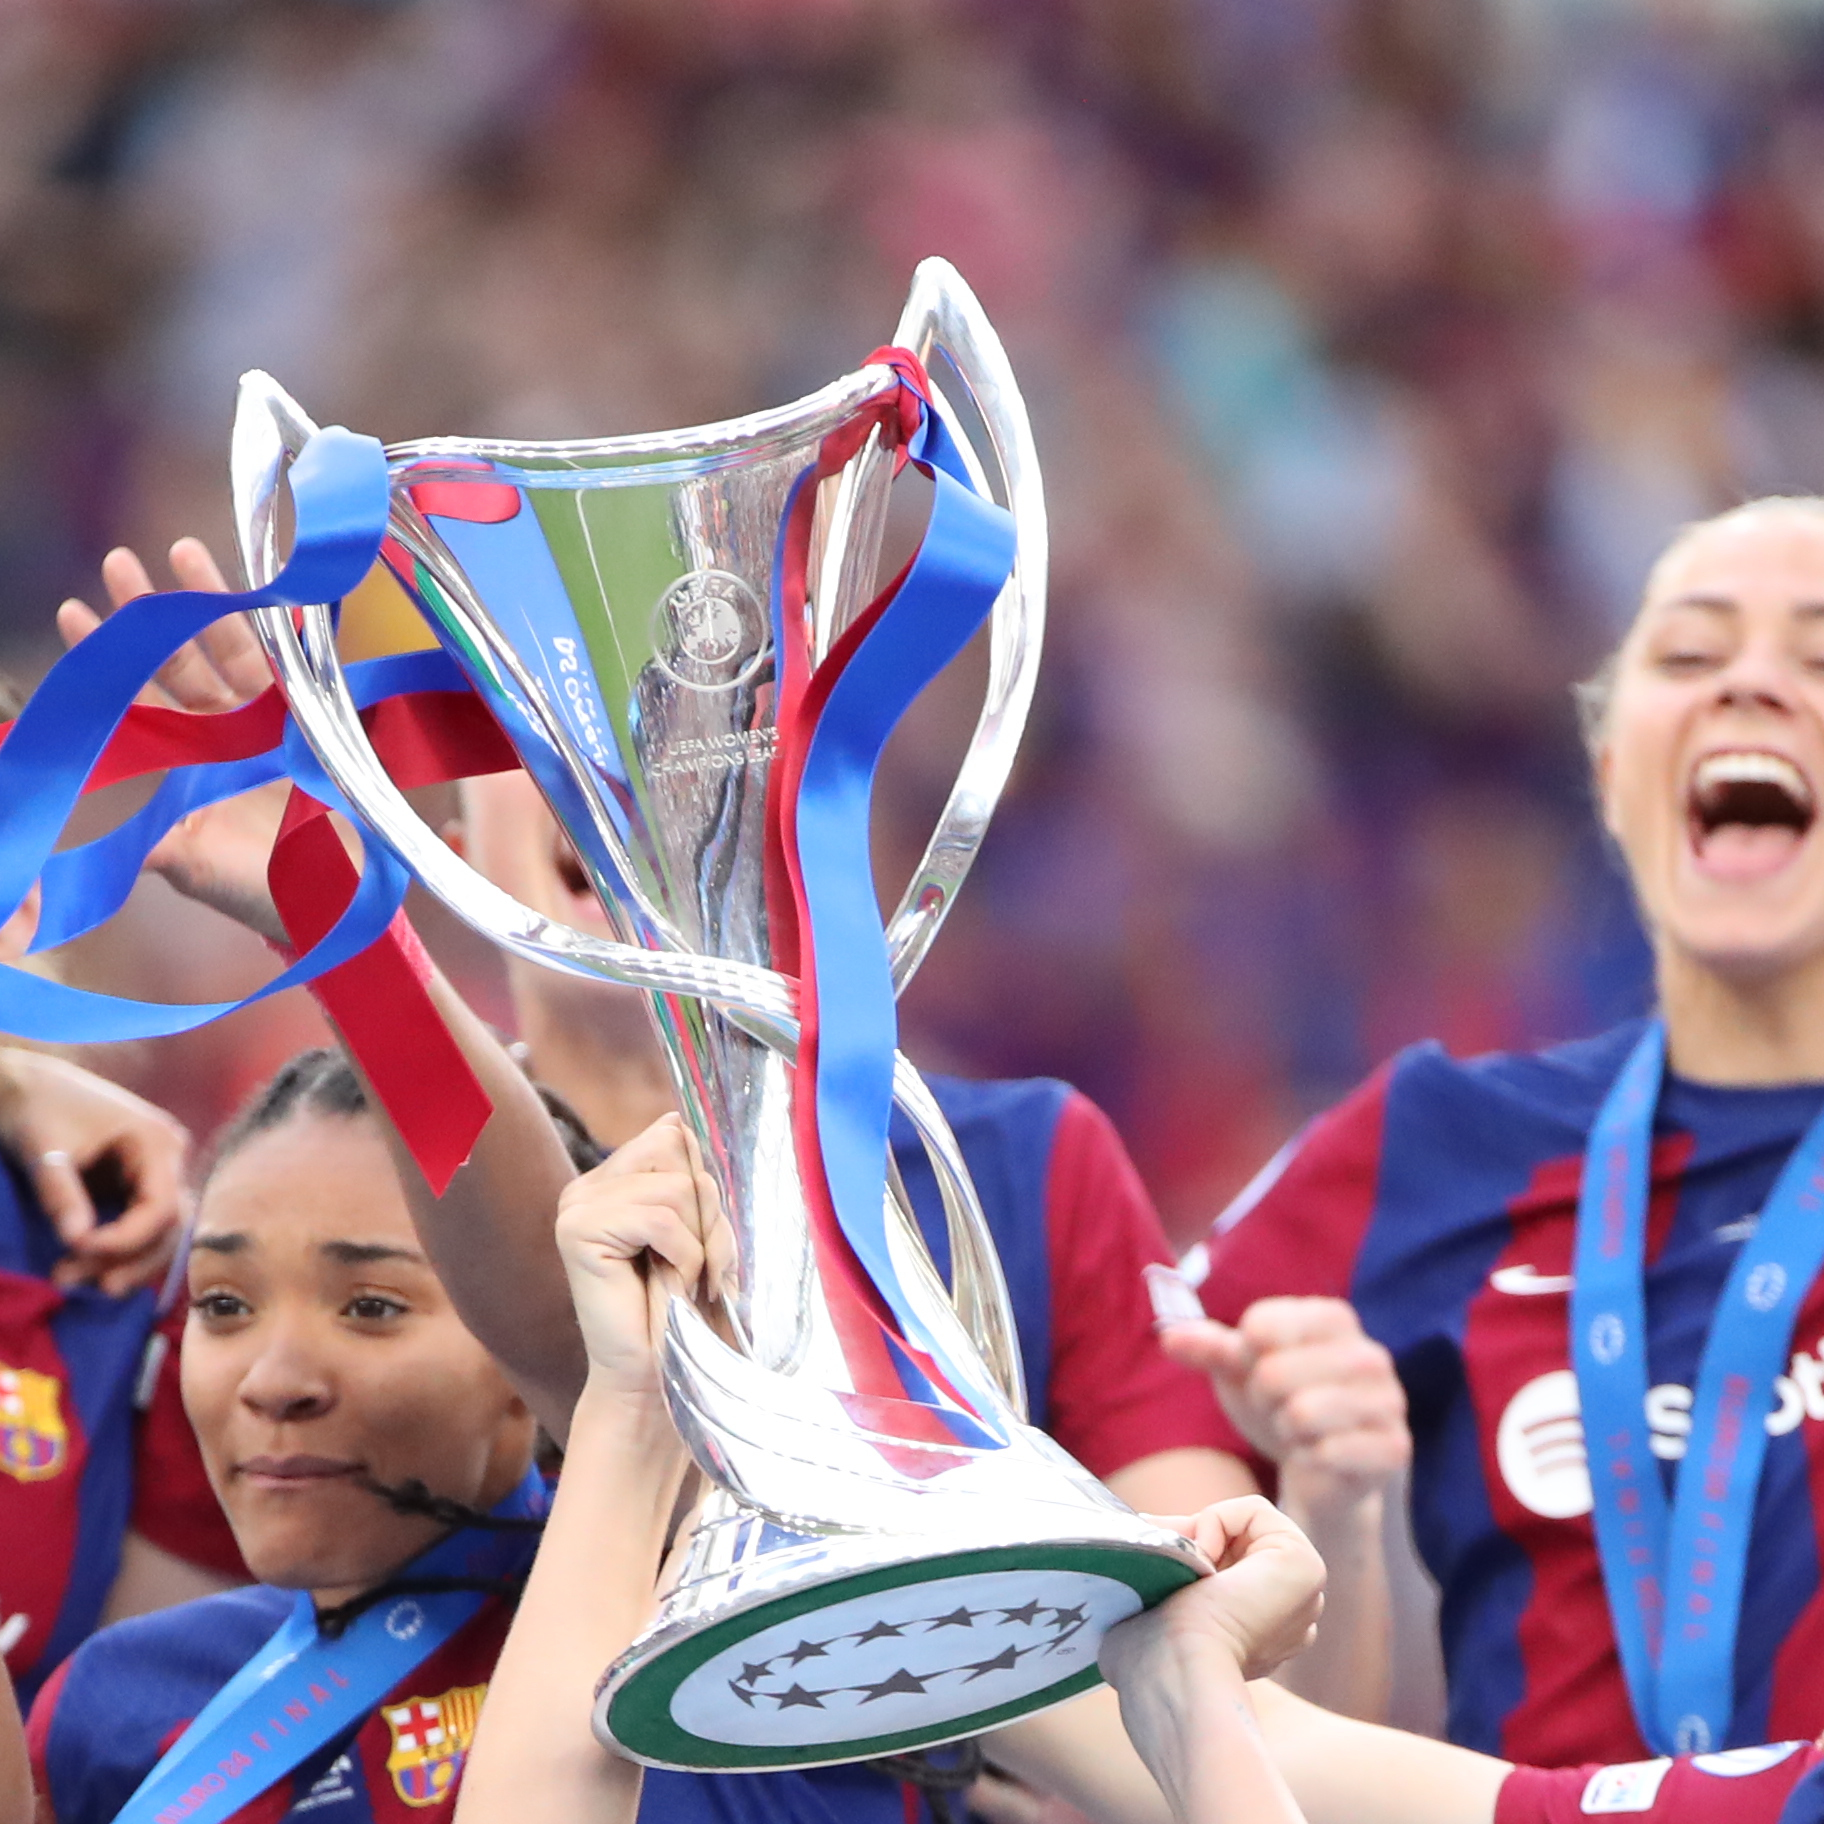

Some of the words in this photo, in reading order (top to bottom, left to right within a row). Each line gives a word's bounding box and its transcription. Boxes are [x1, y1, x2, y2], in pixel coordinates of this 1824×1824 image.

[707, 727, 780, 749] WOMEN'S
[651, 751, 744, 776] CHAMPIONS
[250, 1669, 350, 1752] FINAL
